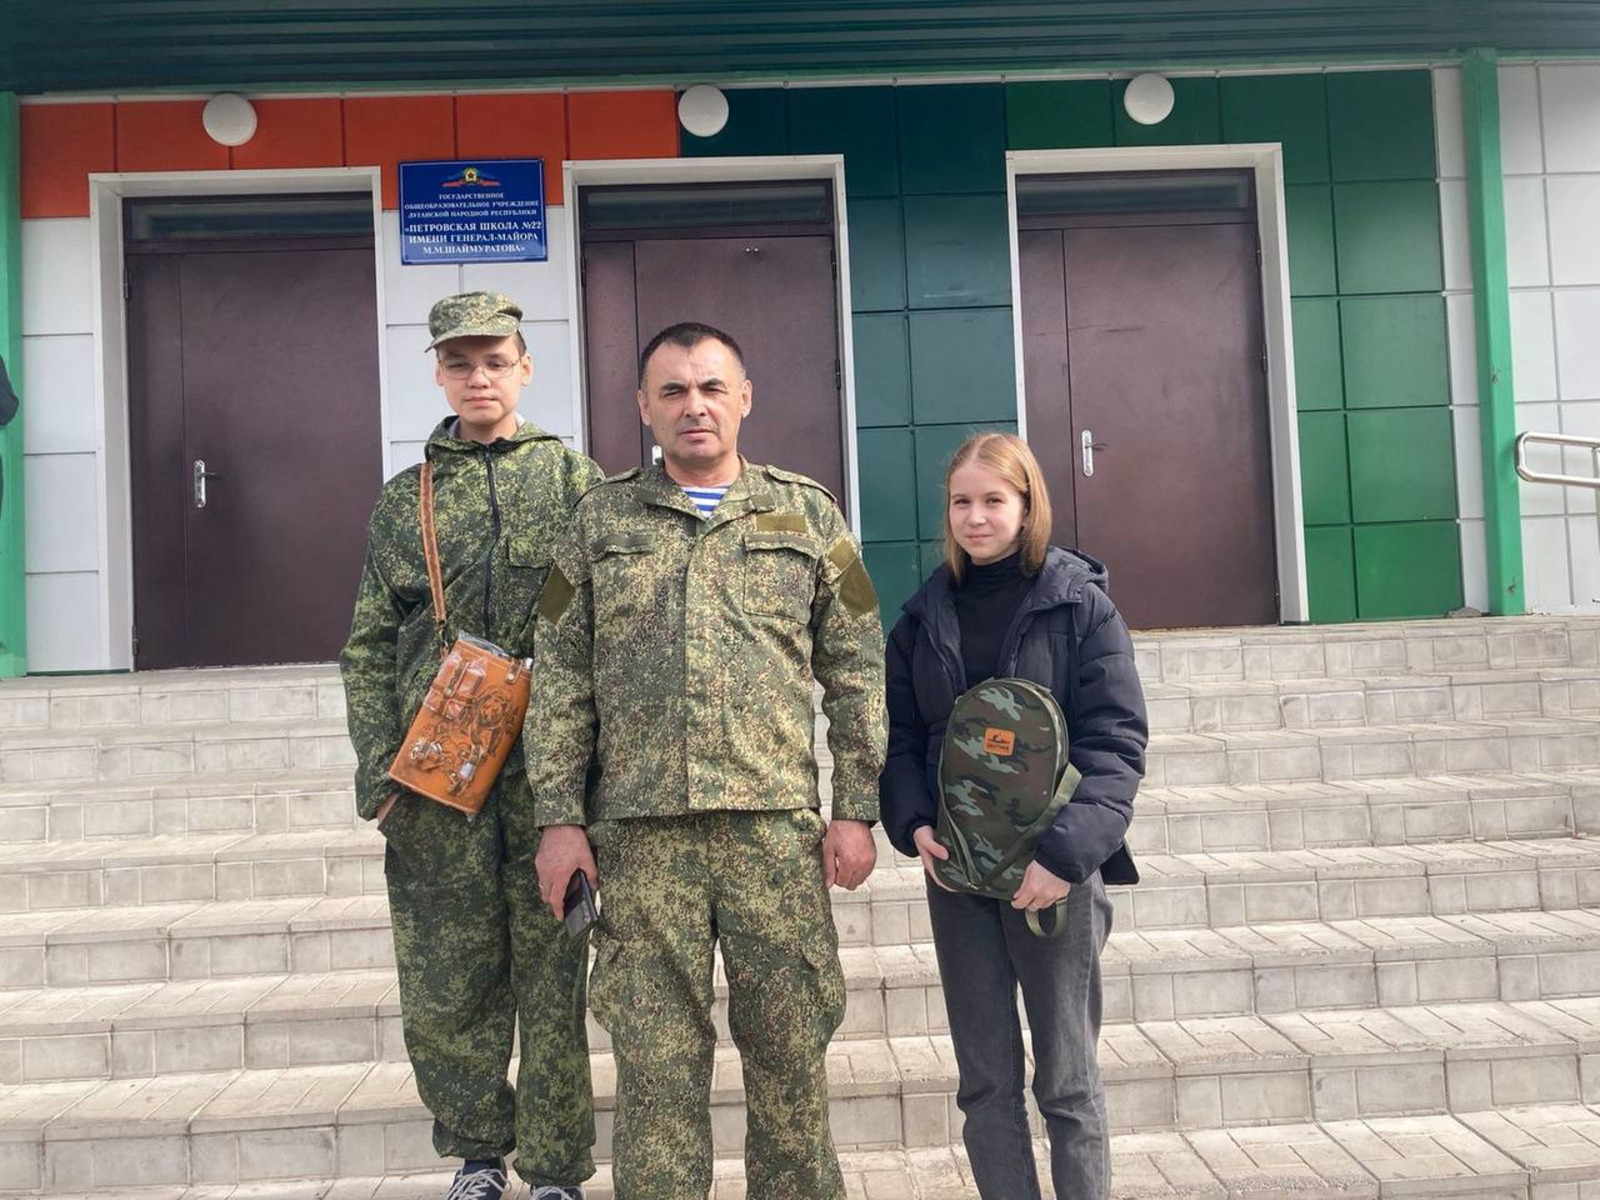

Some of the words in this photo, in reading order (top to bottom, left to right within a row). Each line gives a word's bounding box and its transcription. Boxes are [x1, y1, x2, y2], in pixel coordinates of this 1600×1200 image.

[439, 192, 504, 200] ГОСУДАРСТВЕННОЕ
[404, 201, 490, 210] ОБЩЕОБРАЗОВАТЕЛЬНОЕ
[408, 210, 449, 219] ЛУГАНСКОЙ
[450, 209, 489, 217] НАРОДНОЙ
[404, 222, 477, 233] «ПЕТРОВСКАЯ
[480, 221, 519, 231] ШКОЛА
[521, 221, 542, 230] №22
[409, 235, 447, 244] ИМЕНИ
[450, 232, 539, 242] ГЕНЕРАЛ-МАЙОРА
[422, 243, 526, 254] М.М.ШАЙМУРАТОВА»
